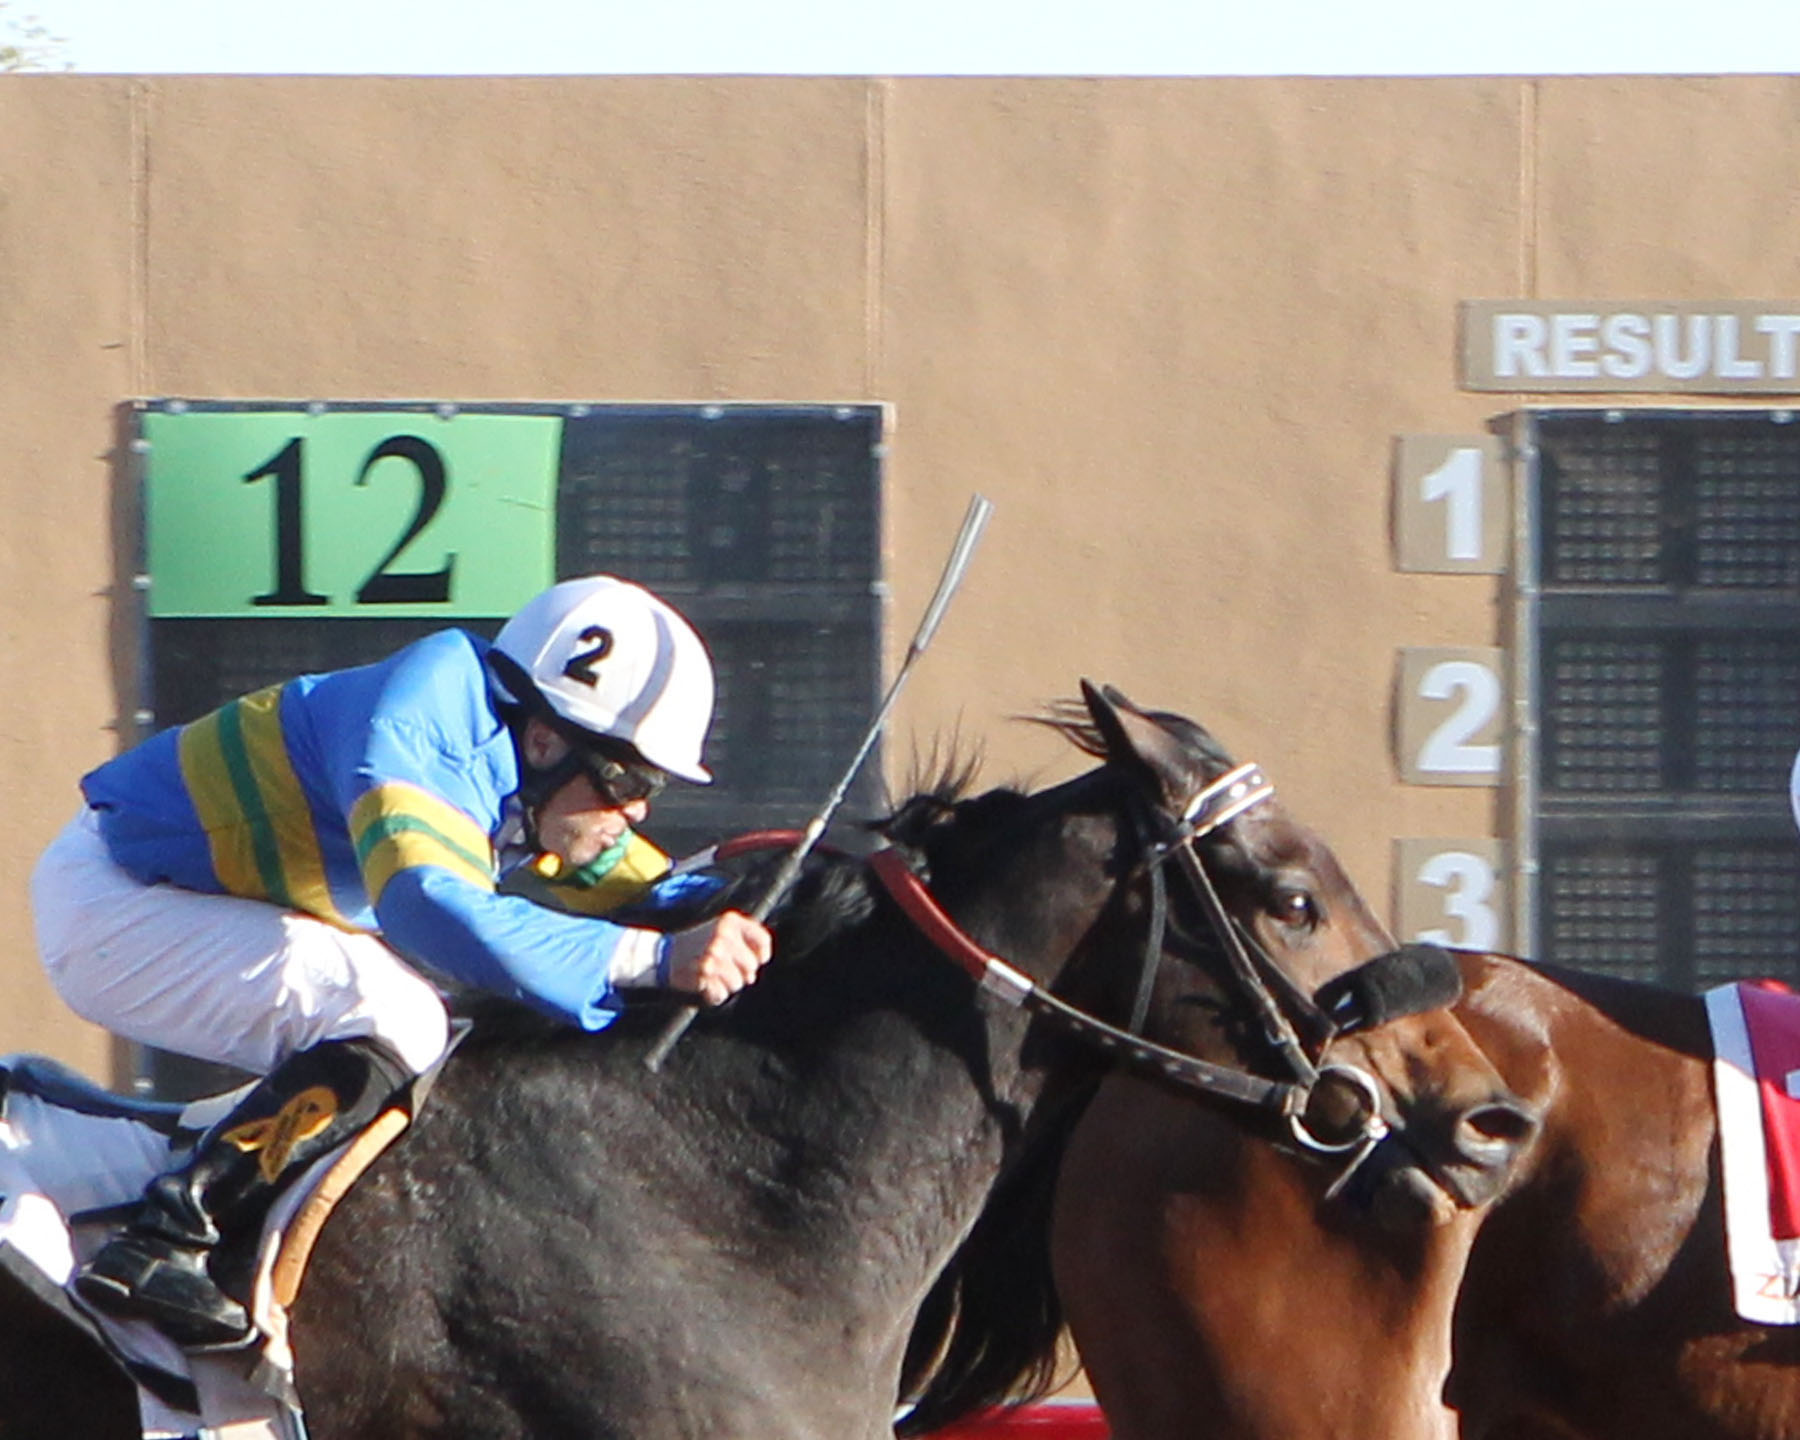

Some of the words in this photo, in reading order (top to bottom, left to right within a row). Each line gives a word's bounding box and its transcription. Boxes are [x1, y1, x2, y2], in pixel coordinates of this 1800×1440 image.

[242, 434, 456, 606] 12
[1420, 448, 1482, 559] 1
[563, 625, 615, 689] 2
[1415, 661, 1501, 772] 2
[1415, 852, 1500, 949] 3
